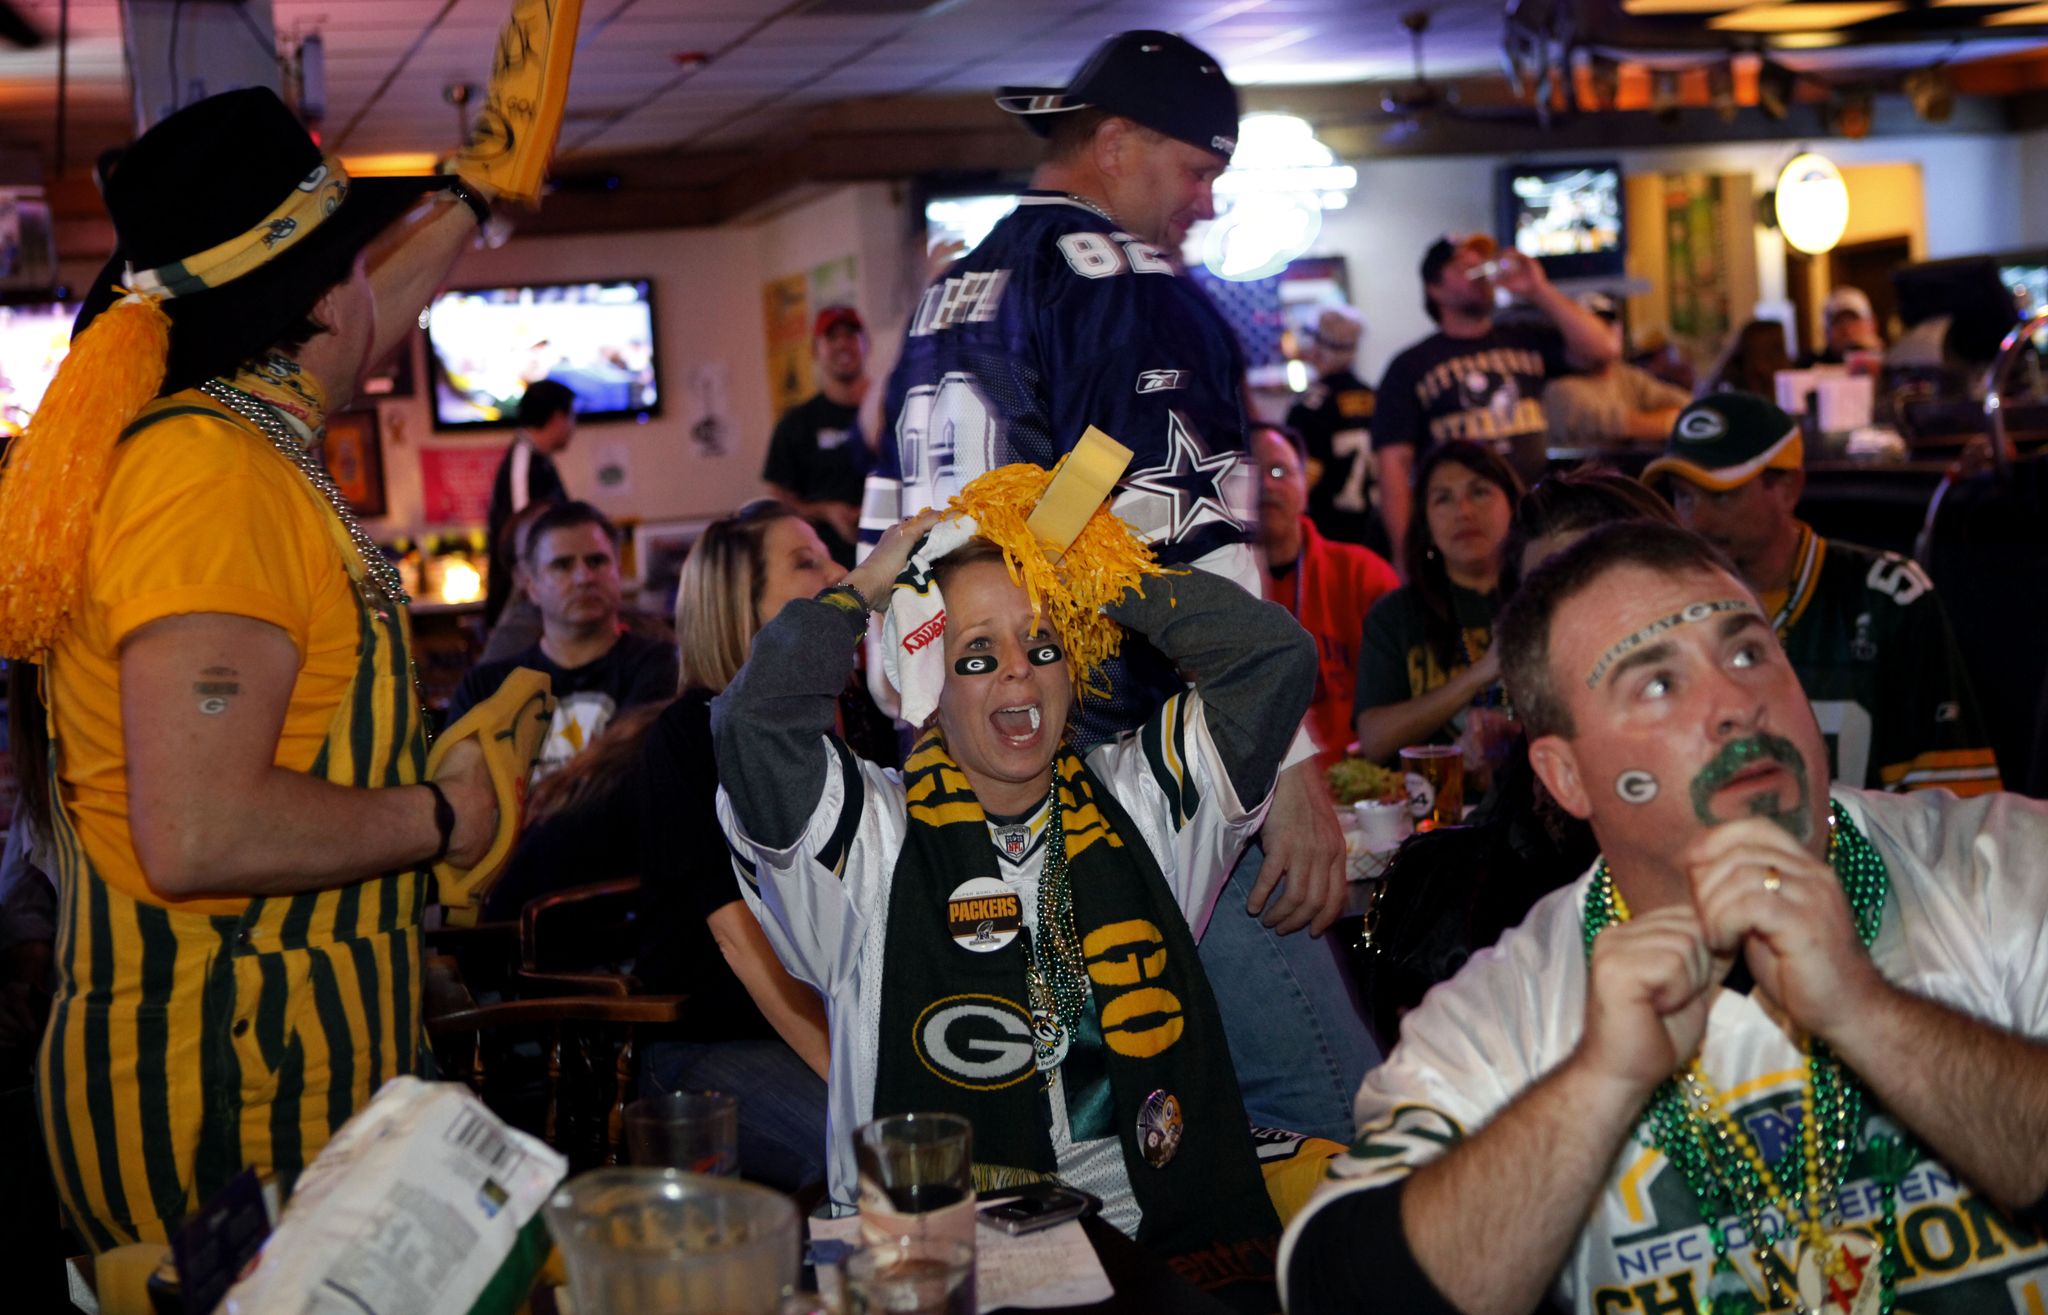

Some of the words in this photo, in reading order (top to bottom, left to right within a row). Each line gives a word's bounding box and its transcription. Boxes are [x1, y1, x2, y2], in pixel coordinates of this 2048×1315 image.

[1056, 231, 1175, 279] 82
[1679, 409, 1722, 439] G
[1331, 428, 1381, 511] 7
[967, 659, 985, 671] G
[1038, 649, 1055, 661] G
[200, 697, 225, 715] G
[1615, 770, 1658, 804] G
[949, 896, 1018, 924] PACKERS
[1083, 918, 1186, 1059] GO
[922, 1004, 1034, 1079] G
[1616, 1233, 1703, 1281] NFC
